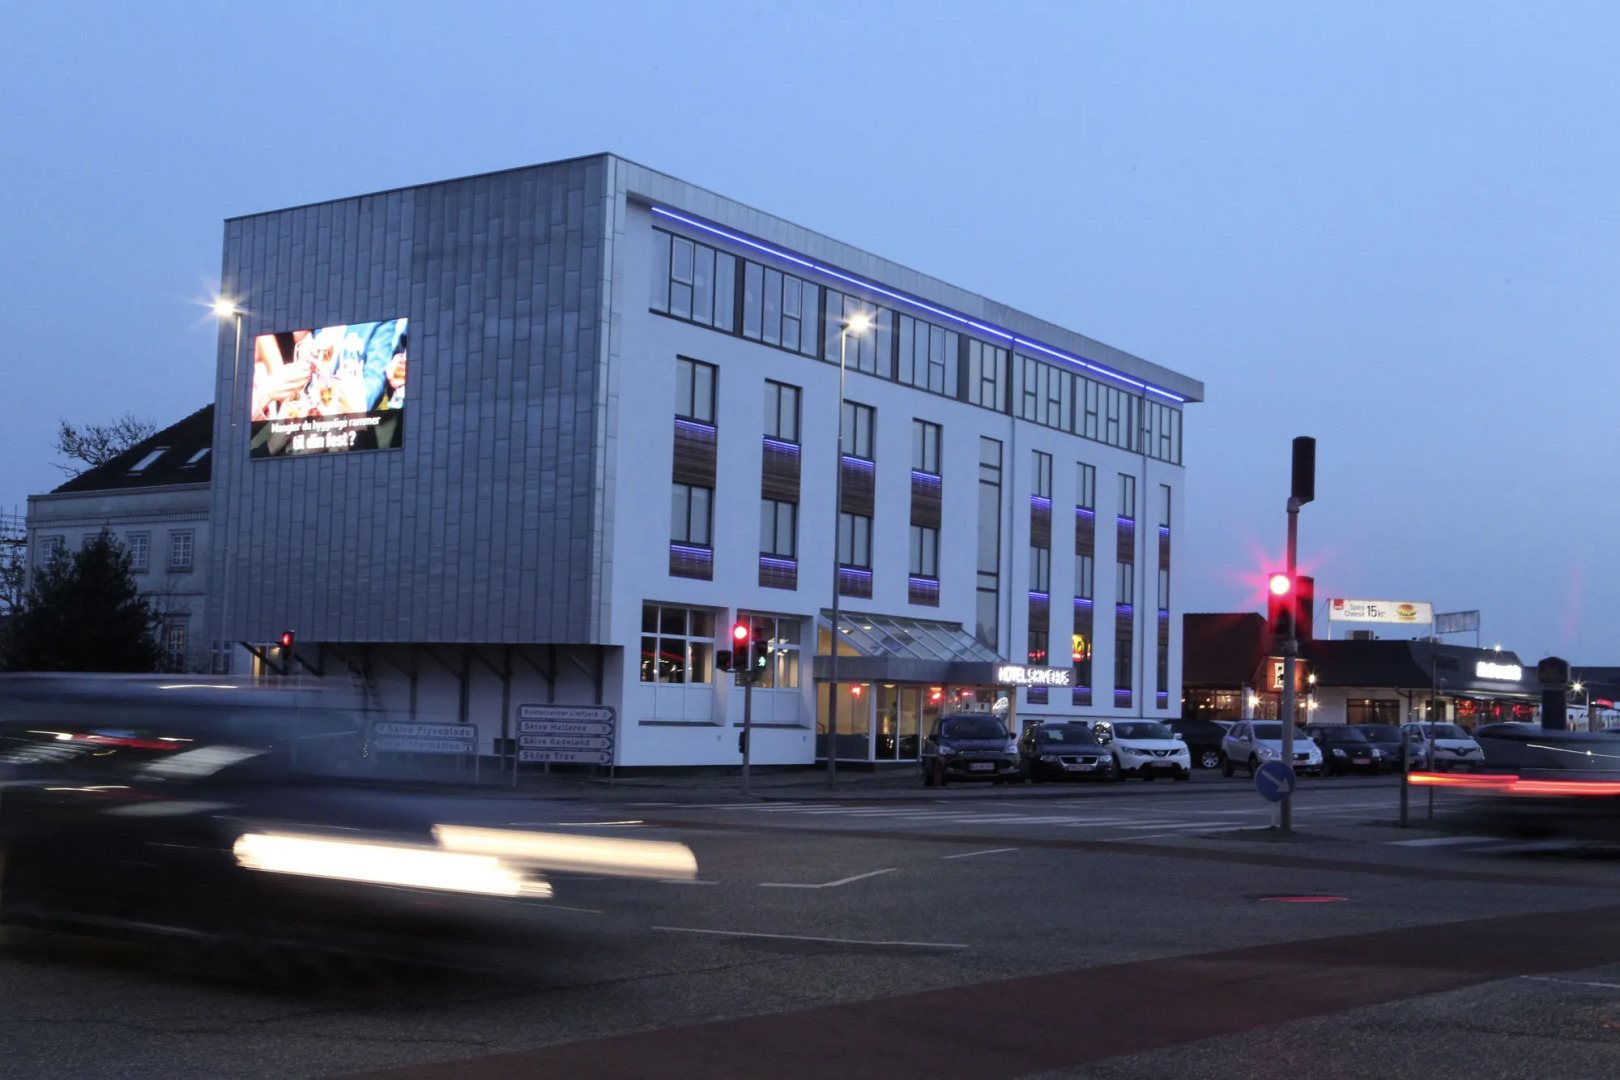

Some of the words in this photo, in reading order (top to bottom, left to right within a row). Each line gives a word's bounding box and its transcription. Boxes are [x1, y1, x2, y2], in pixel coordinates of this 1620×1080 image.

[1367, 605, 1377, 618] 15
[999, 666, 1027, 683] HOTEL
[524, 722, 548, 730] Skive
[524, 737, 548, 745] Skive
[523, 751, 551, 760] Skive
[553, 752, 576, 761] Trav
